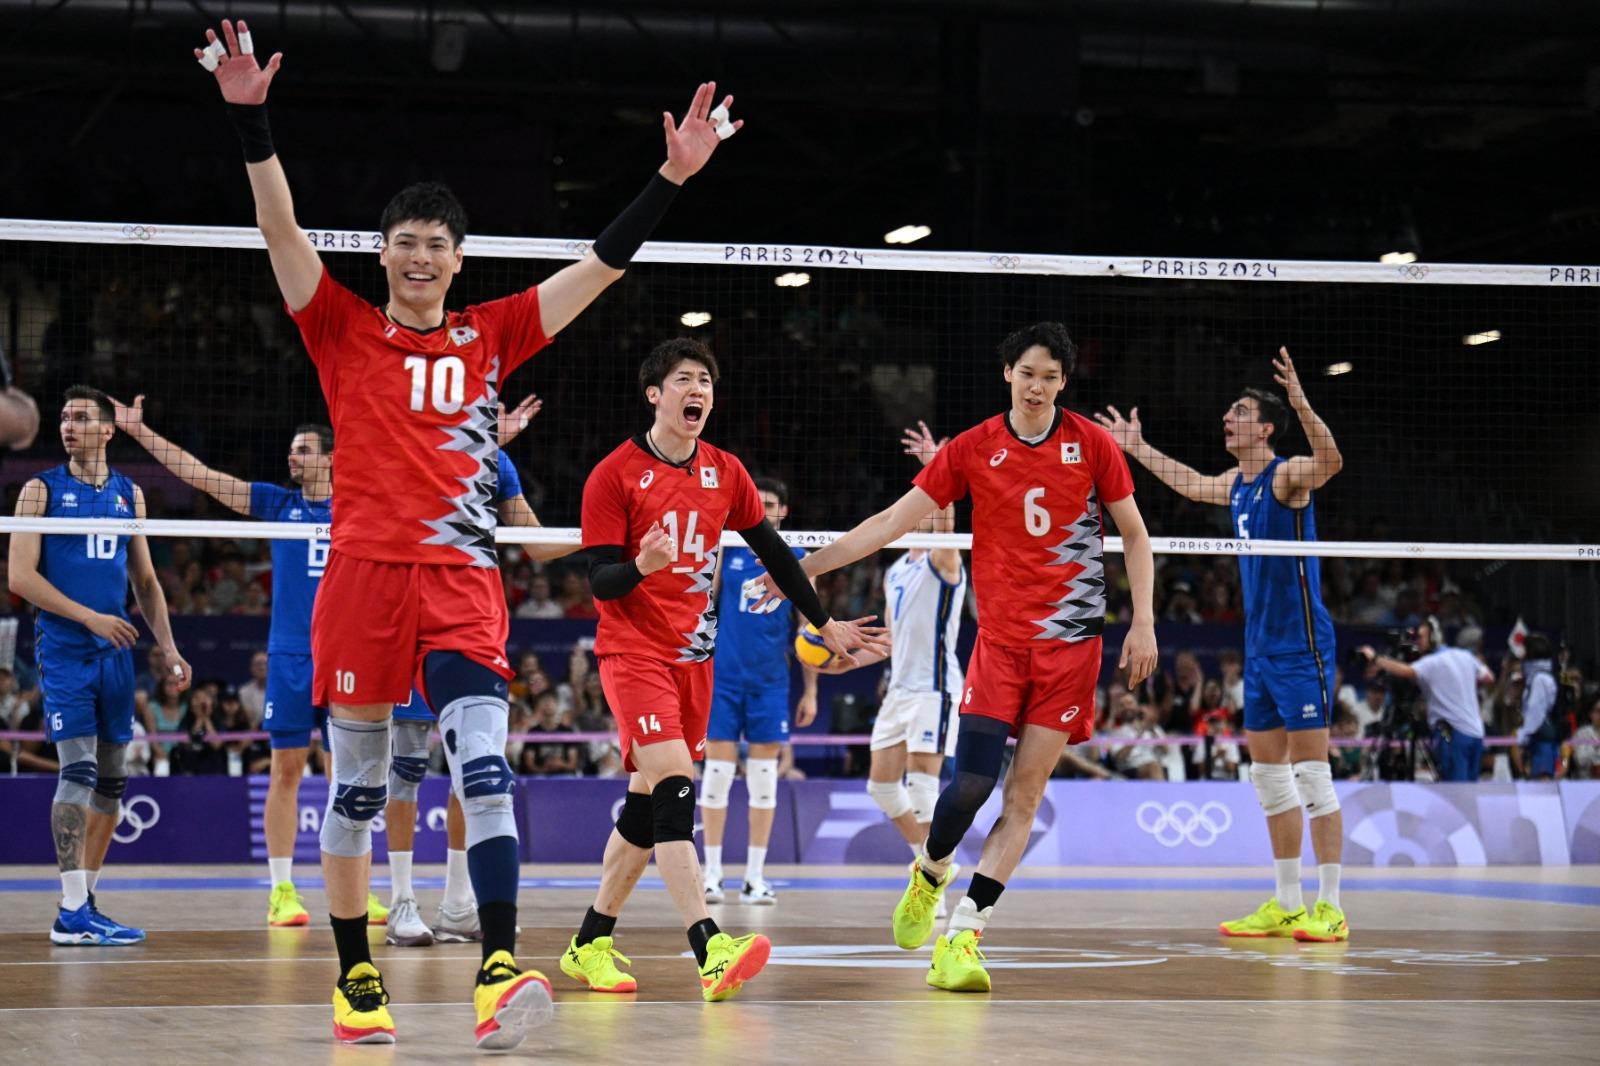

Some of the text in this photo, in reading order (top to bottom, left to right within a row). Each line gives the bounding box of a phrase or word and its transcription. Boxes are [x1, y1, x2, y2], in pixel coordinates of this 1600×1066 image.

[404, 355, 466, 415] 10
[1024, 487, 1051, 537] 6
[662, 510, 705, 563] 14
[895, 585, 904, 621] 7
[335, 669, 356, 695] 10
[965, 687, 973, 705] 6
[265, 702, 274, 719] 6
[638, 714, 662, 735] 14
